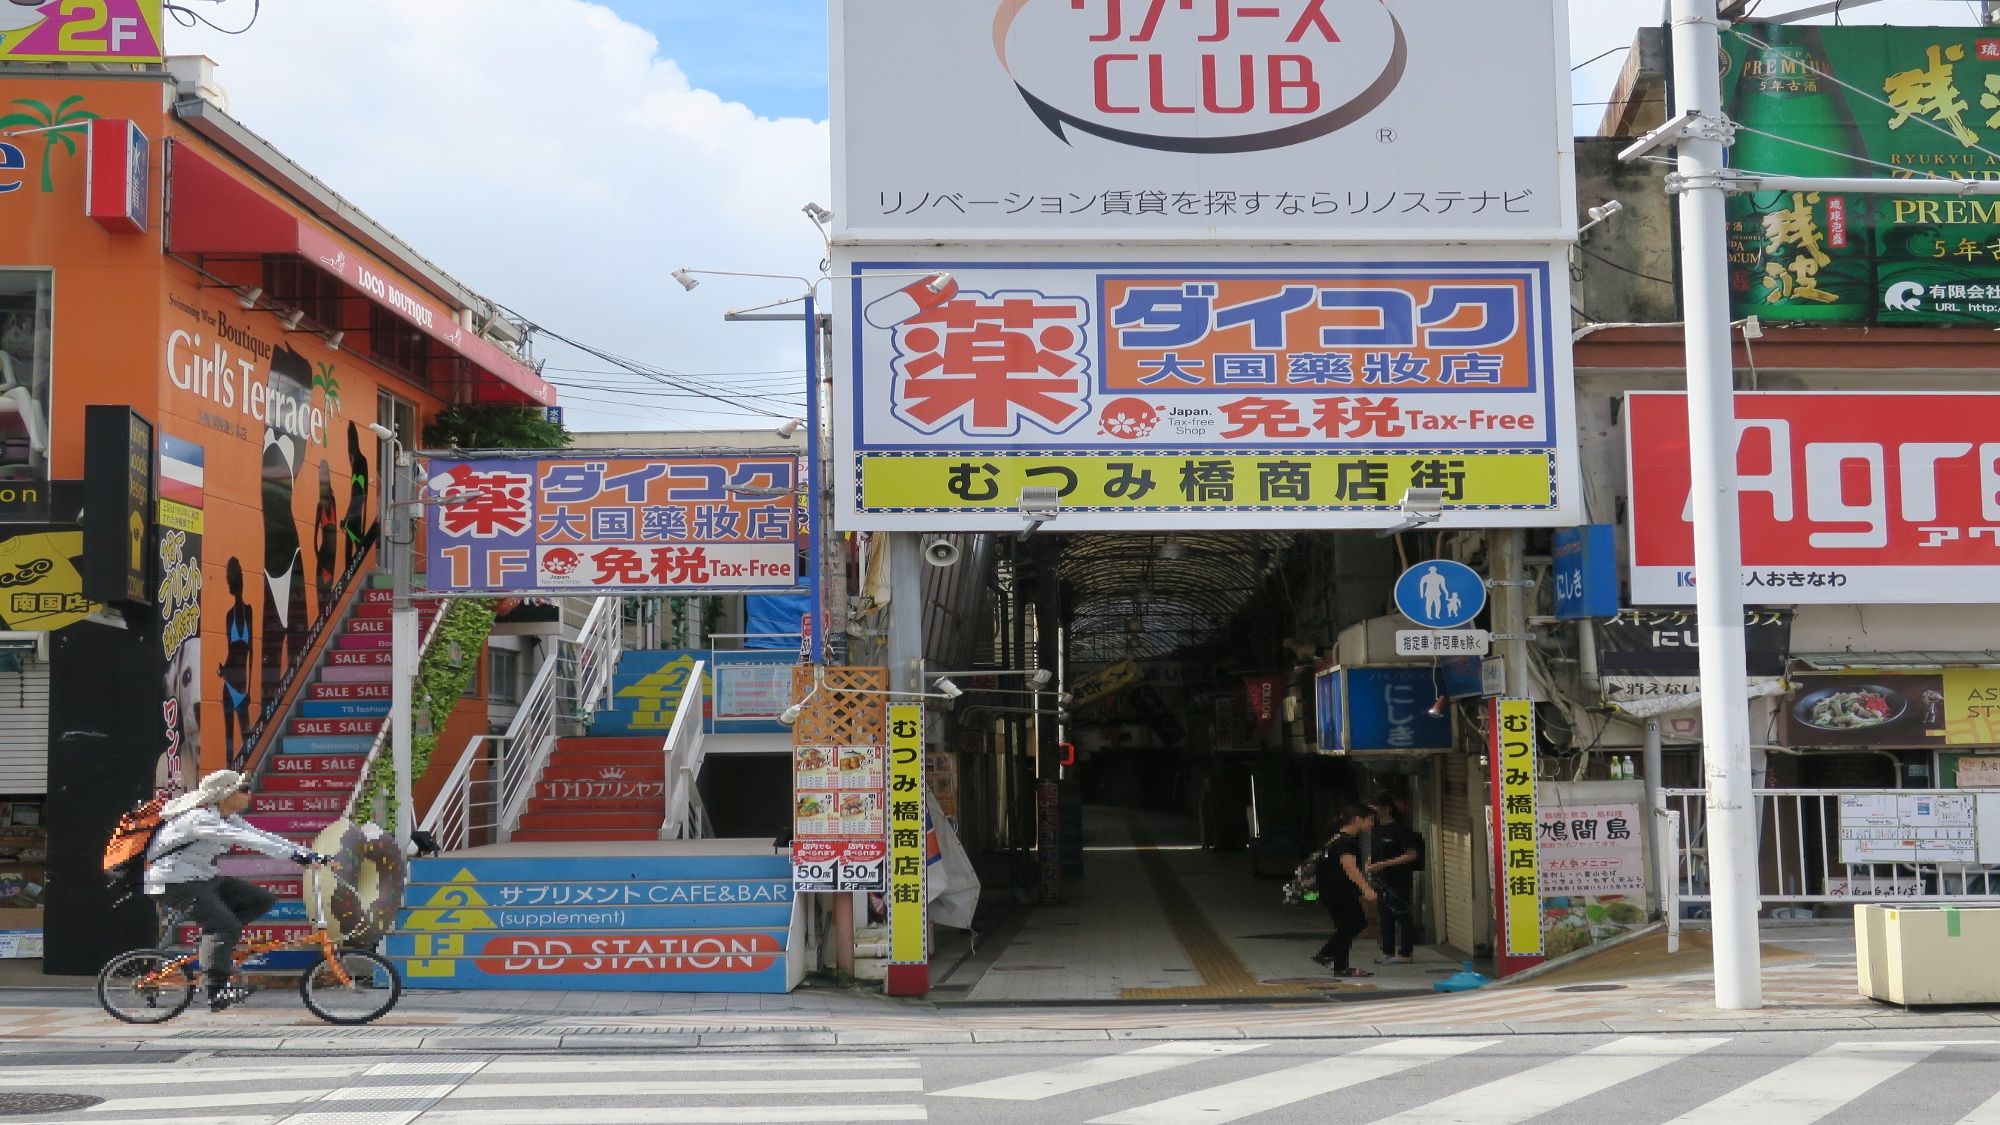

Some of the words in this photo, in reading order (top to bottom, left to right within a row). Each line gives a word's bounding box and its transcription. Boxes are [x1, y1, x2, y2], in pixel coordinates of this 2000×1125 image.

[1094, 54, 1321, 114] CLUB
[1891, 154, 1974, 165] RYUKYU
[880, 190, 1533, 216] リノベーション賃貸を探すならリノステナビ
[358, 266, 384, 298] LOCO
[388, 288, 434, 329] BOUTIQUE
[1936, 303, 1961, 312] URL
[1112, 283, 1520, 351] ダイコク
[217, 310, 271, 363] Boutique
[167, 329, 234, 408] Girl's
[237, 357, 323, 445] Terrace
[1167, 418, 1216, 427] Tax-free
[1218, 396, 1404, 438] 免税
[1405, 409, 1536, 431] Tax-Free
[1175, 427, 1208, 437] Shop
[541, 463, 793, 503] ダイコク
[949, 460, 1467, 501] むつみ橋商店街
[441, 544, 531, 588] 1F
[591, 546, 709, 585] 免税
[709, 558, 791, 577] Tax-Free
[1741, 571, 1847, 587] 人おきなわ
[11, 593, 91, 613] 南国店
[369, 592, 393, 602] SAL
[353, 622, 384, 632] SALE
[1603, 611, 1782, 627] スキンケウス
[1403, 635, 1482, 651] 指定車・許可車を除く
[1652, 630, 1700, 648] にし
[335, 654, 367, 664] SALE
[317, 687, 350, 697] SALE
[357, 686, 389, 696] SALE
[1385, 684, 1415, 747] にしき
[298, 724, 332, 734] SALE
[339, 723, 373, 733] SALE
[278, 760, 312, 770] SALE
[322, 759, 356, 769] SALE
[892, 719, 920, 904] むつみ橋商店街
[1503, 713, 1536, 896] むつみ橋商店街
[1539, 818, 1631, 841] 鳩間島
[500, 885, 641, 904] サプリメント
[648, 884, 787, 902] CAFE&BAR
[799, 882, 813, 890] 2F
[844, 882, 858, 890] 2F
[500, 910, 625, 926] (supplement)
[504, 940, 572, 970] DD
[583, 937, 757, 970] STATION
